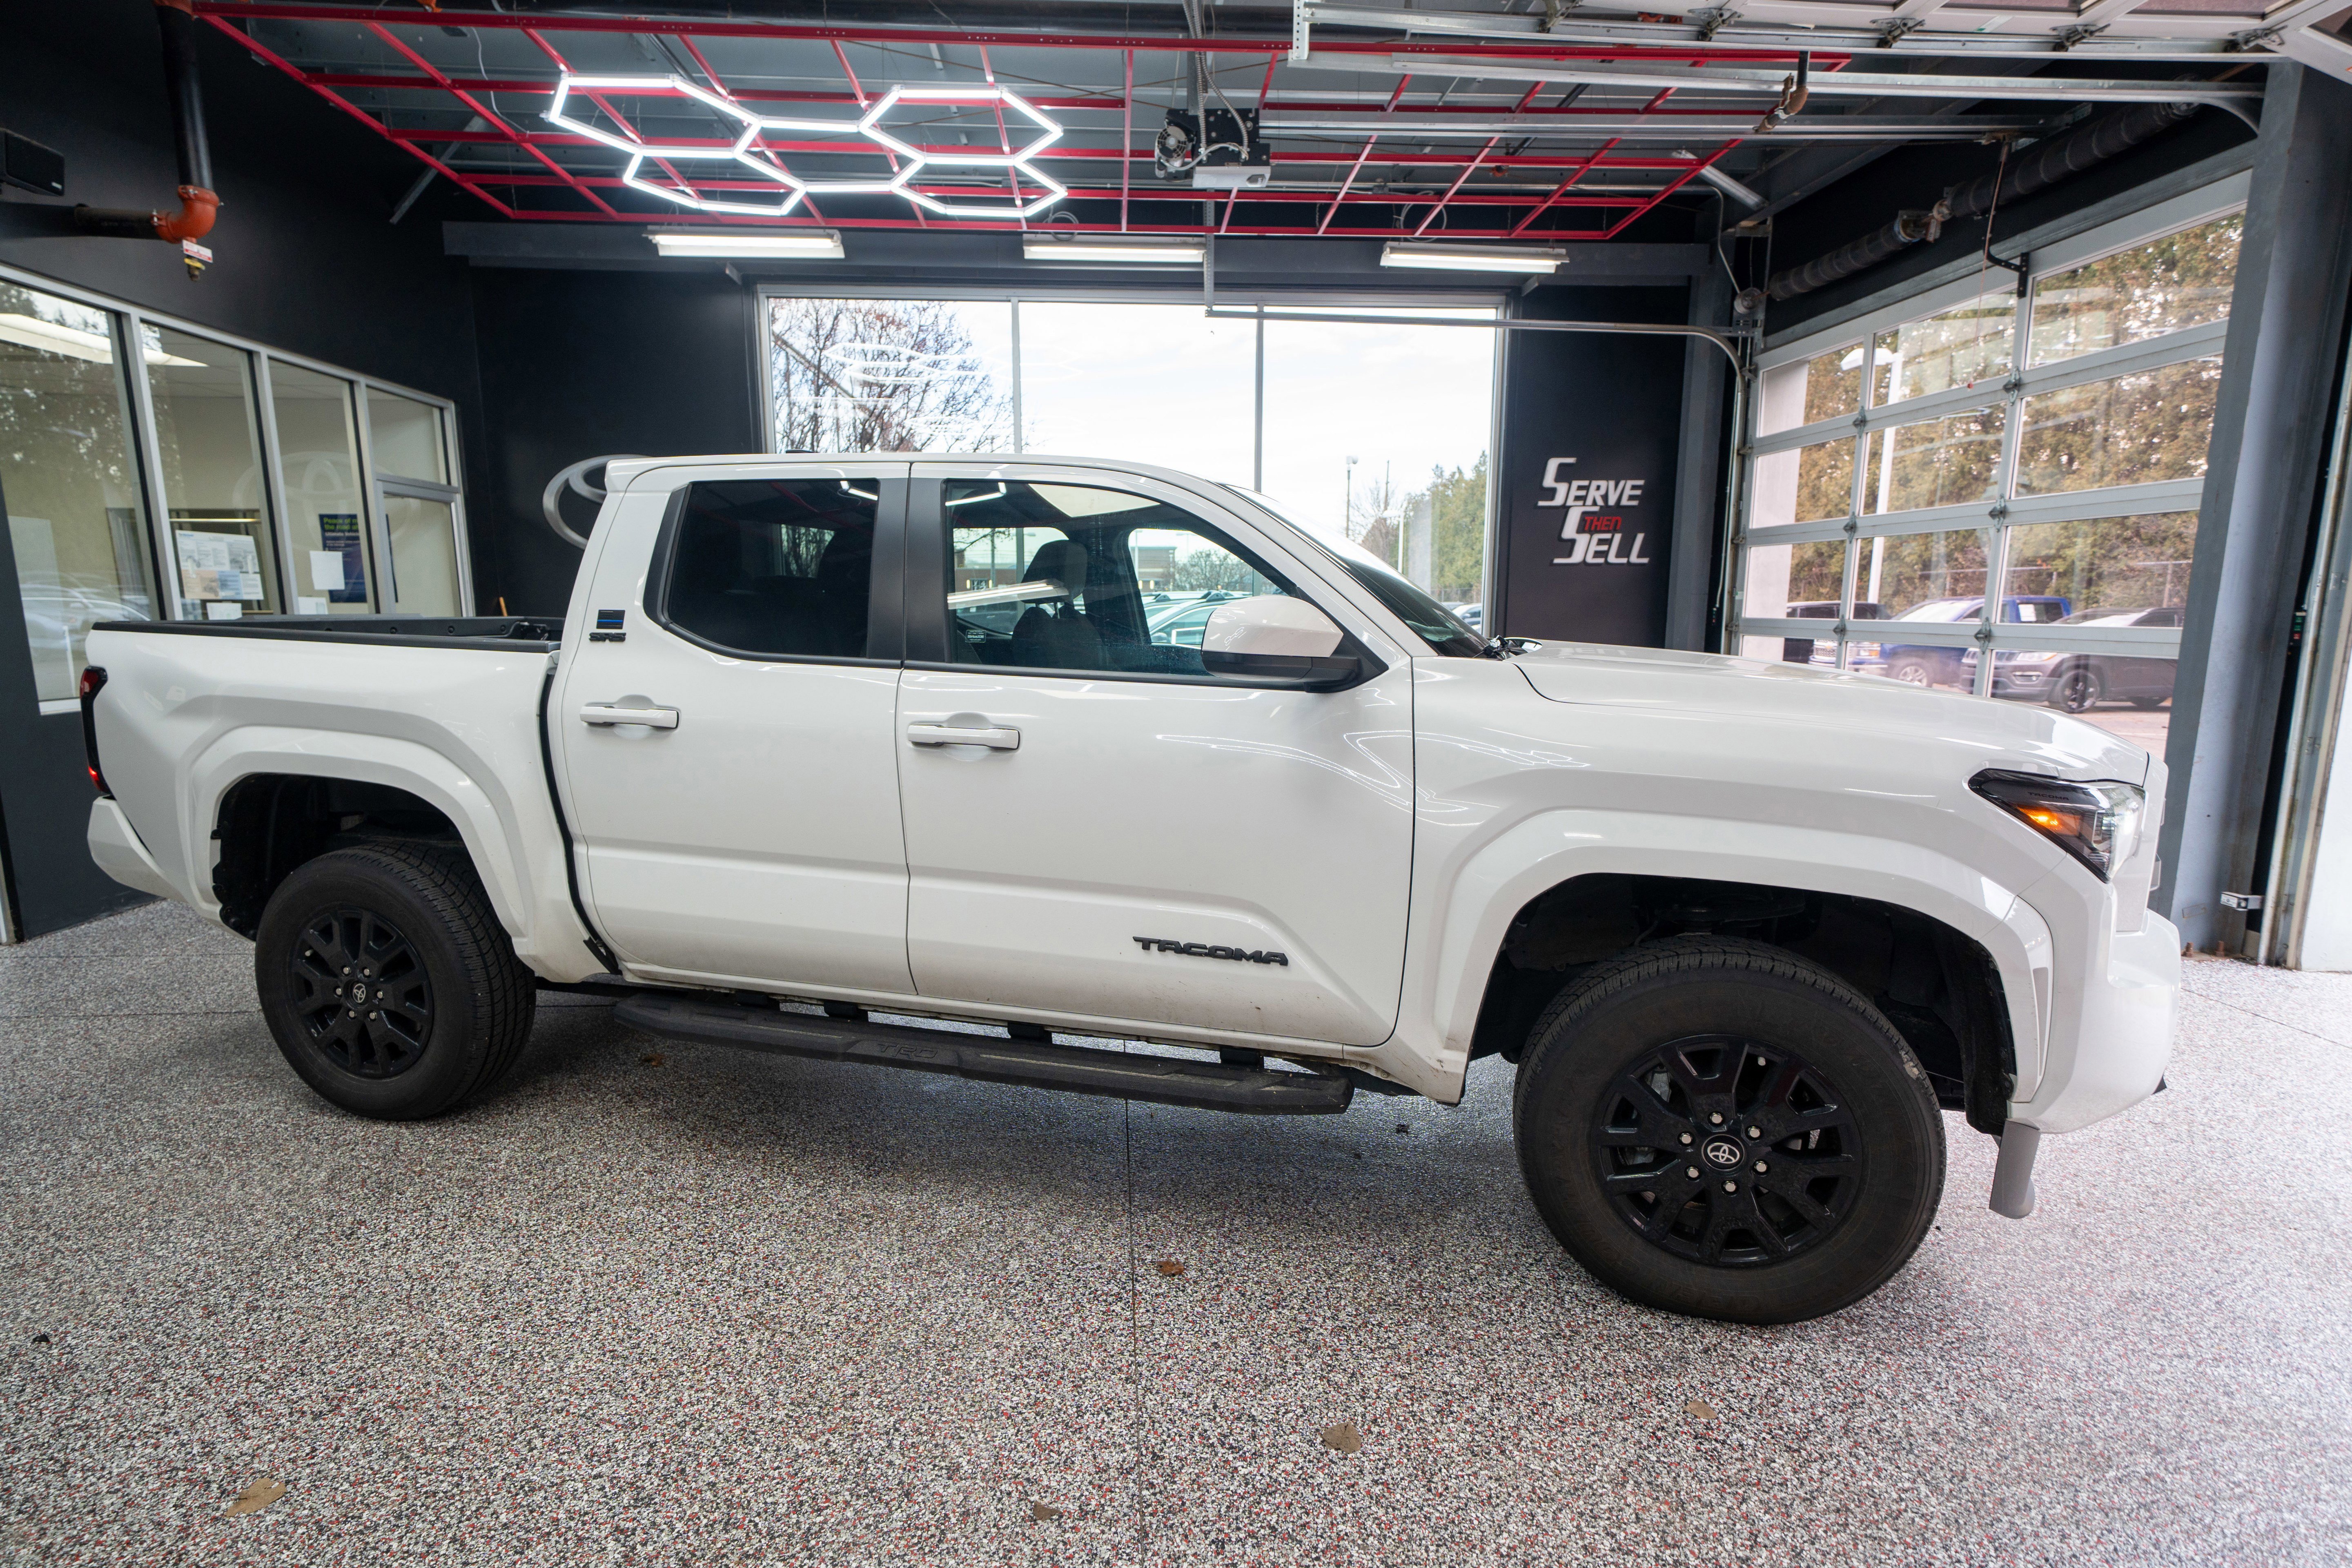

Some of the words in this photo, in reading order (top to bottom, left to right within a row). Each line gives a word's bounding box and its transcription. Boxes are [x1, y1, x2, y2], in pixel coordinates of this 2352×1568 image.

[1537, 457, 1645, 506] SERVE
[1584, 516, 1622, 530] THEN
[1552, 506, 1649, 564] SELL
[589, 632, 626, 642] SR5
[2027, 792, 2069, 800] TACOMA
[1133, 936, 1288, 966] TACOMA
[878, 1042, 939, 1060] TRD
